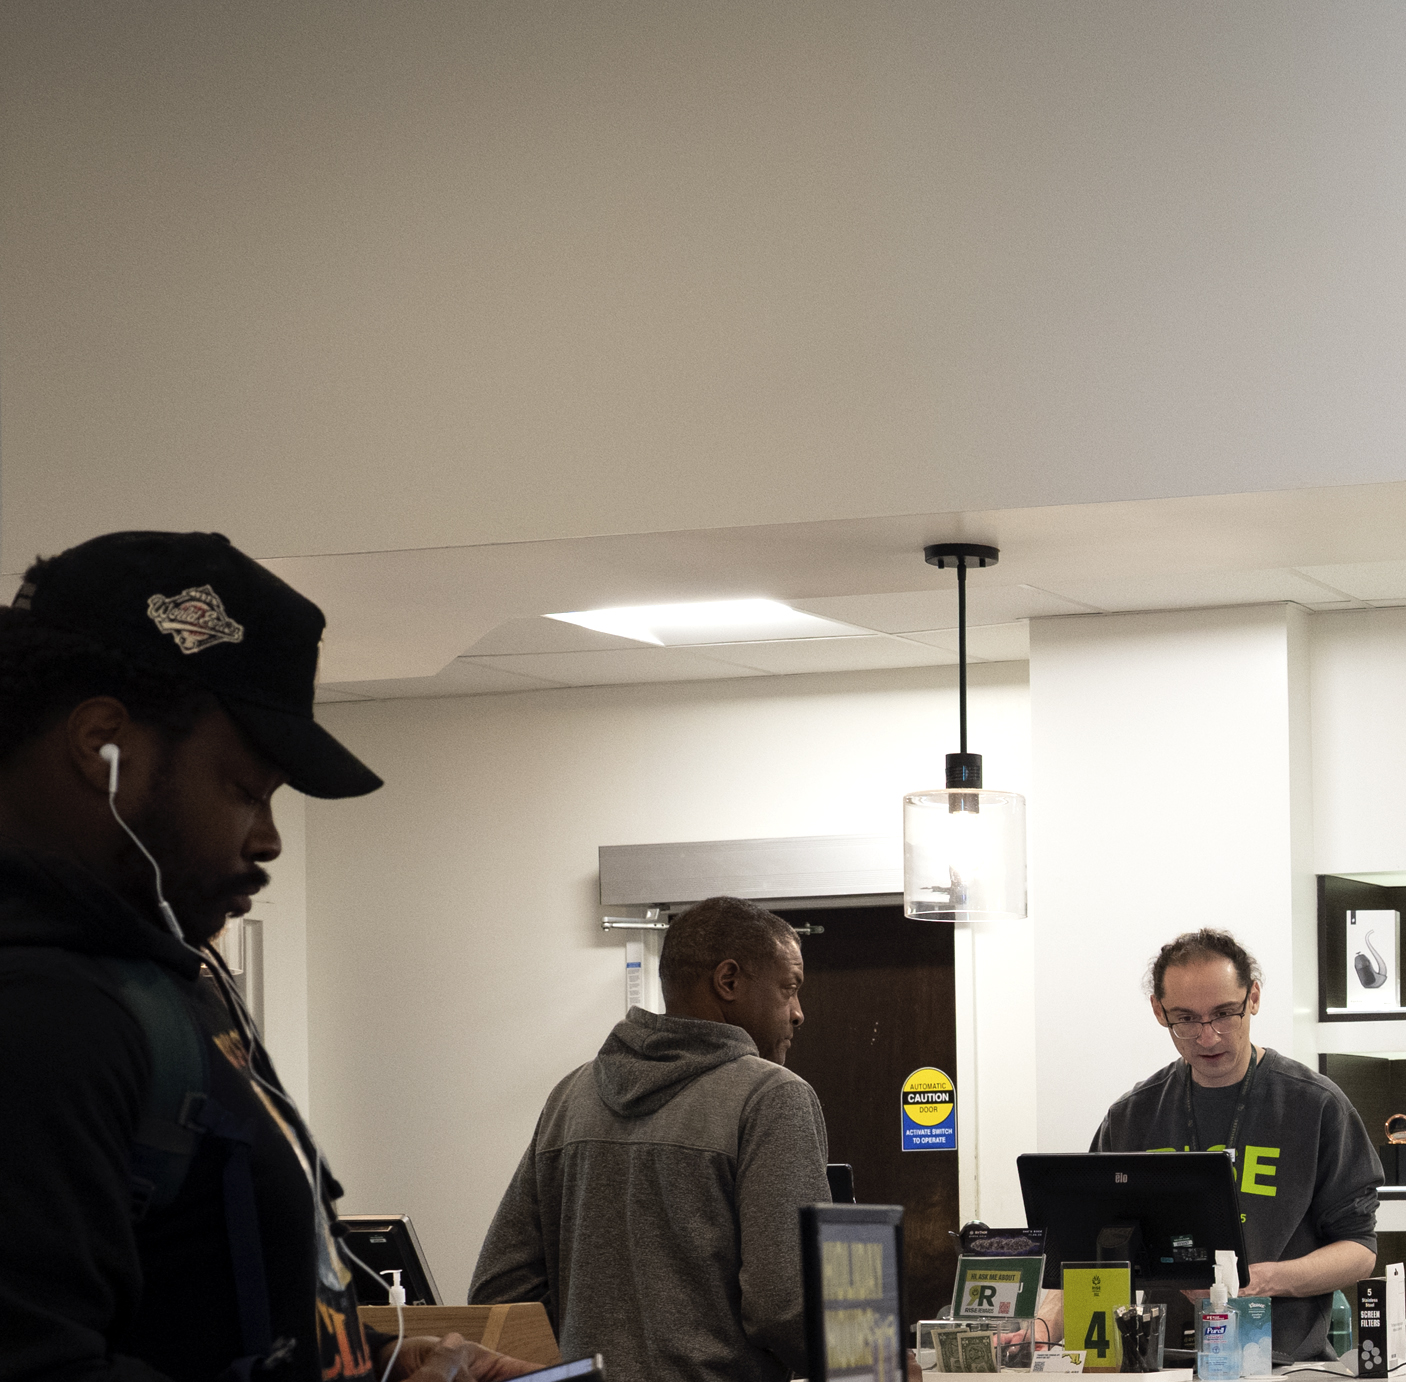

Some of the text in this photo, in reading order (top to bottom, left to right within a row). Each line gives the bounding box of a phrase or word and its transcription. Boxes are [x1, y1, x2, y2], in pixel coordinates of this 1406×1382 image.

[907, 1093, 949, 1103] CAUTION
[920, 1136, 946, 1144] OPERATE
[977, 1273, 989, 1281] ASK
[998, 1274, 1016, 1282] ABOUT
[1366, 1288, 1372, 1296] 5
[1360, 1310, 1380, 1319] SCREEN
[1360, 1319, 1381, 1328] FILTERS
[1084, 1311, 1110, 1359] 4
